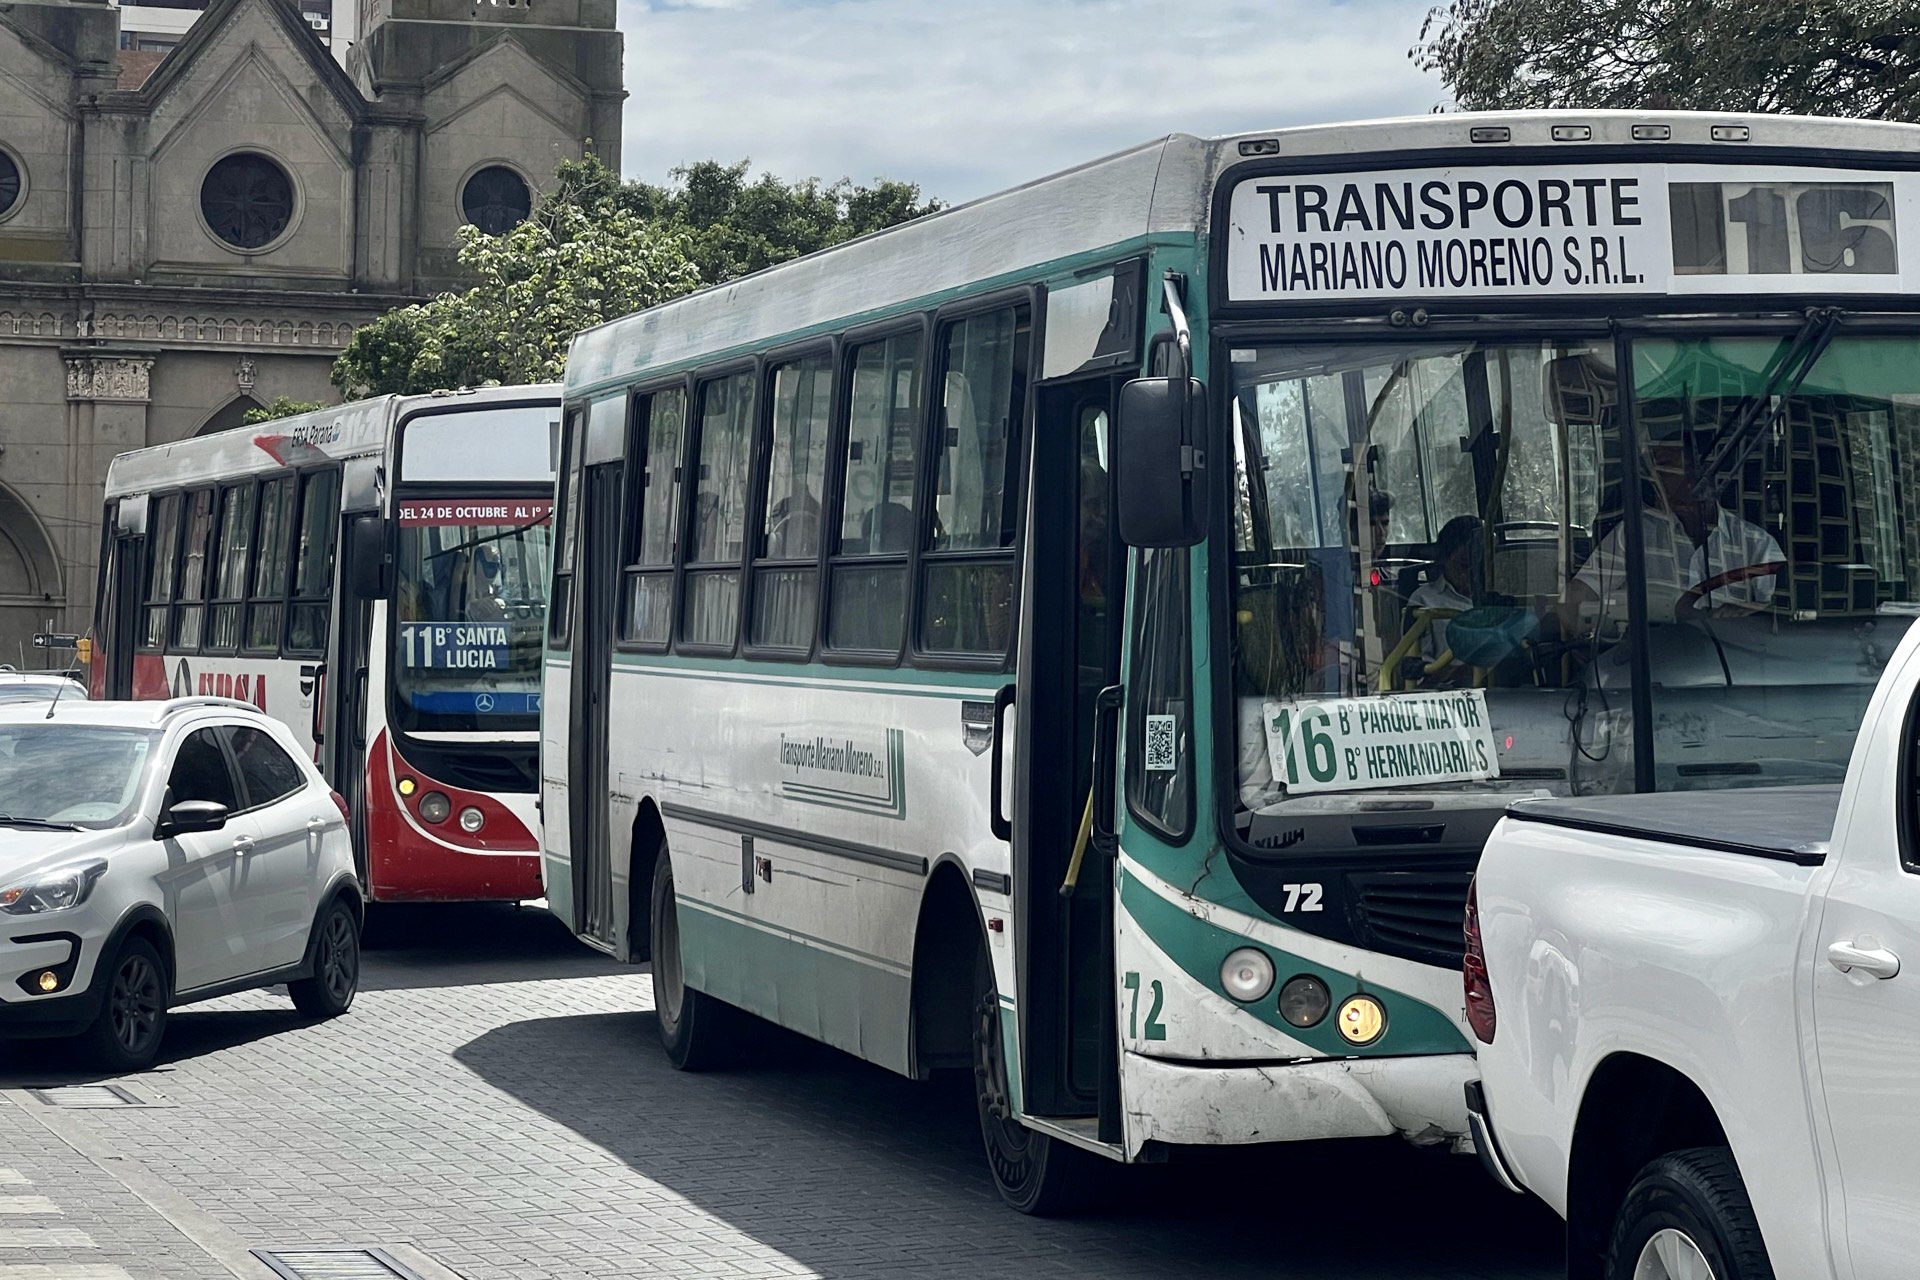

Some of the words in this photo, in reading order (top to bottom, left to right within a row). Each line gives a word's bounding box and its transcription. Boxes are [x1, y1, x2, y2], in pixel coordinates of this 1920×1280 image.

[1256, 178, 1641, 233] TRANSPORTE
[1728, 186, 1898, 275] 16
[1259, 239, 1407, 292] MARIANO
[1416, 236, 1553, 288] MORENO
[1563, 235, 1644, 286] S.R.L.
[420, 507, 434, 519] 24
[437, 507, 452, 518] DE
[455, 506, 508, 518] OCTUBRE
[514, 506, 528, 518] AL
[401, 626, 432, 668] 11
[456, 627, 507, 646] SANTA
[446, 650, 496, 668] LUCIA
[1359, 698, 1422, 735] PARQUE
[1424, 696, 1481, 731] MAYOR
[780, 732, 816, 775] Transporte
[815, 736, 844, 773] Mariano
[844, 740, 873, 778] Moreno
[1272, 705, 1338, 785] 16
[1366, 738, 1489, 780] HERNANDARIAS
[1282, 883, 1323, 913] 72
[1124, 971, 1167, 1041] 72
